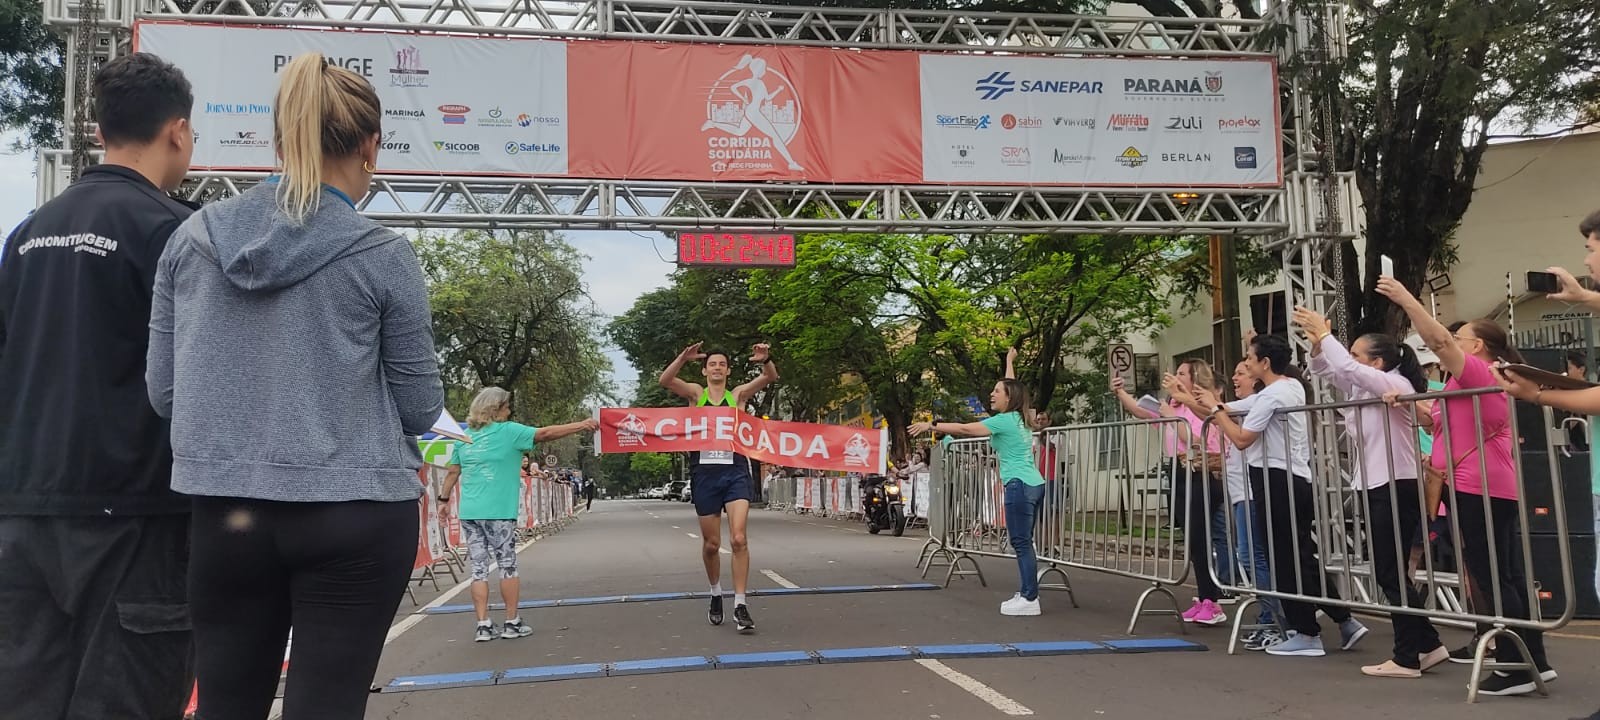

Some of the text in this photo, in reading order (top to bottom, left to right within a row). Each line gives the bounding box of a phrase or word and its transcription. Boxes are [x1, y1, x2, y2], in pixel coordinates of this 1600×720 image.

[1020, 80, 1103, 94] SANEPAR
[1124, 77, 1203, 93] PARANÁ
[1018, 116, 1042, 126] sabin
[445, 143, 480, 151] SICOOB
[519, 143, 560, 153] Safe Life
[708, 137, 772, 148] CORRIDA
[708, 147, 772, 159] SOLIDÁRIA
[1161, 153, 1211, 162] BERLAN
[681, 234, 793, 263] 00:22:48
[654, 416, 830, 459] CHEGADA
